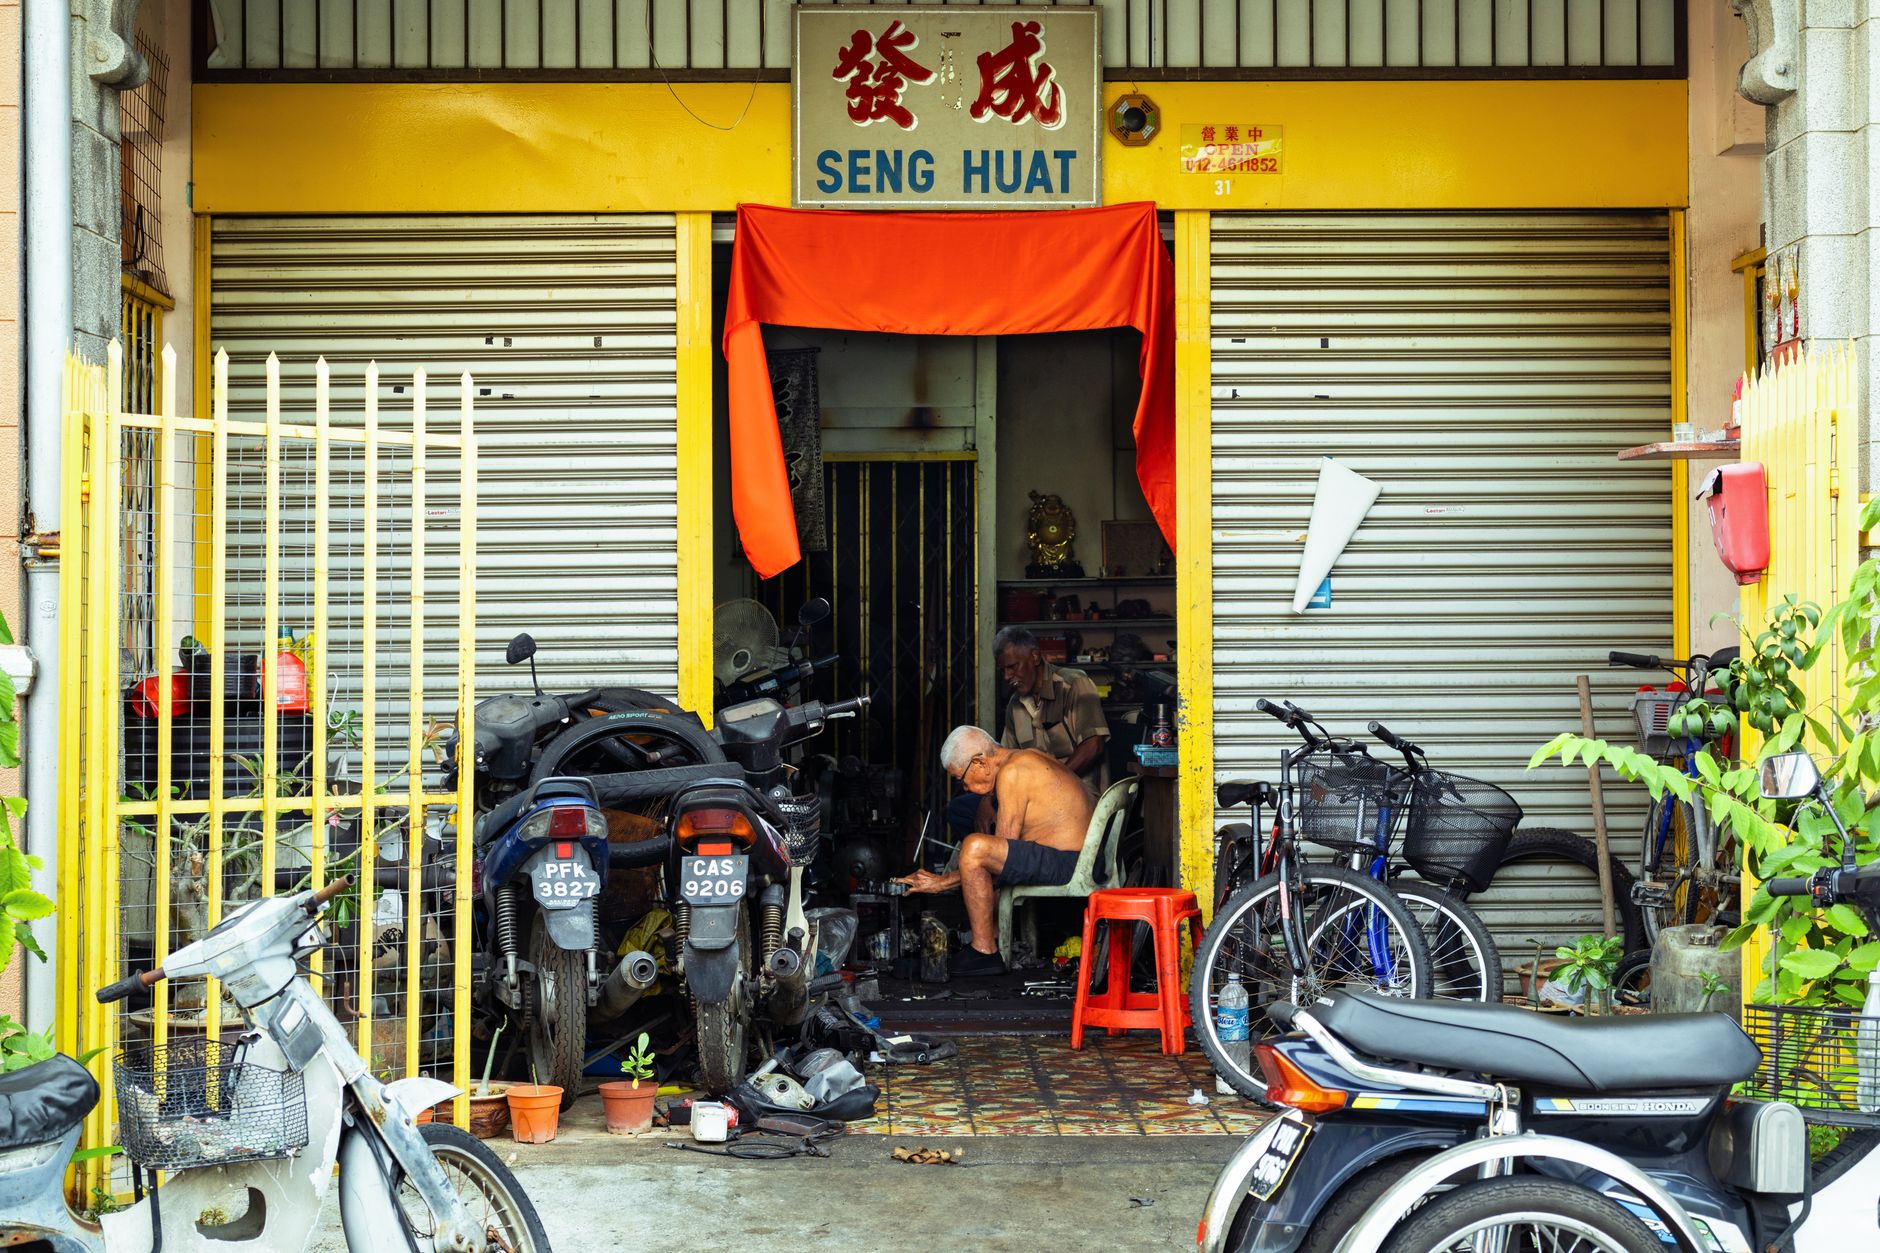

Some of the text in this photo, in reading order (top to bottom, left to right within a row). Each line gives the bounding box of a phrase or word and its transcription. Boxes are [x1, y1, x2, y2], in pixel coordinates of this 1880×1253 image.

[1204, 144, 1259, 156] OPEN
[816, 149, 1077, 194] SENG HUAT
[1186, 157, 1278, 172] 012-4611852
[1215, 180, 1231, 195] 31
[545, 862, 587, 879] PFK
[693, 859, 734, 876] CAS
[538, 881, 597, 897] 3827
[684, 880, 744, 897] 9206
[1642, 1101, 1697, 1112] HONDA
